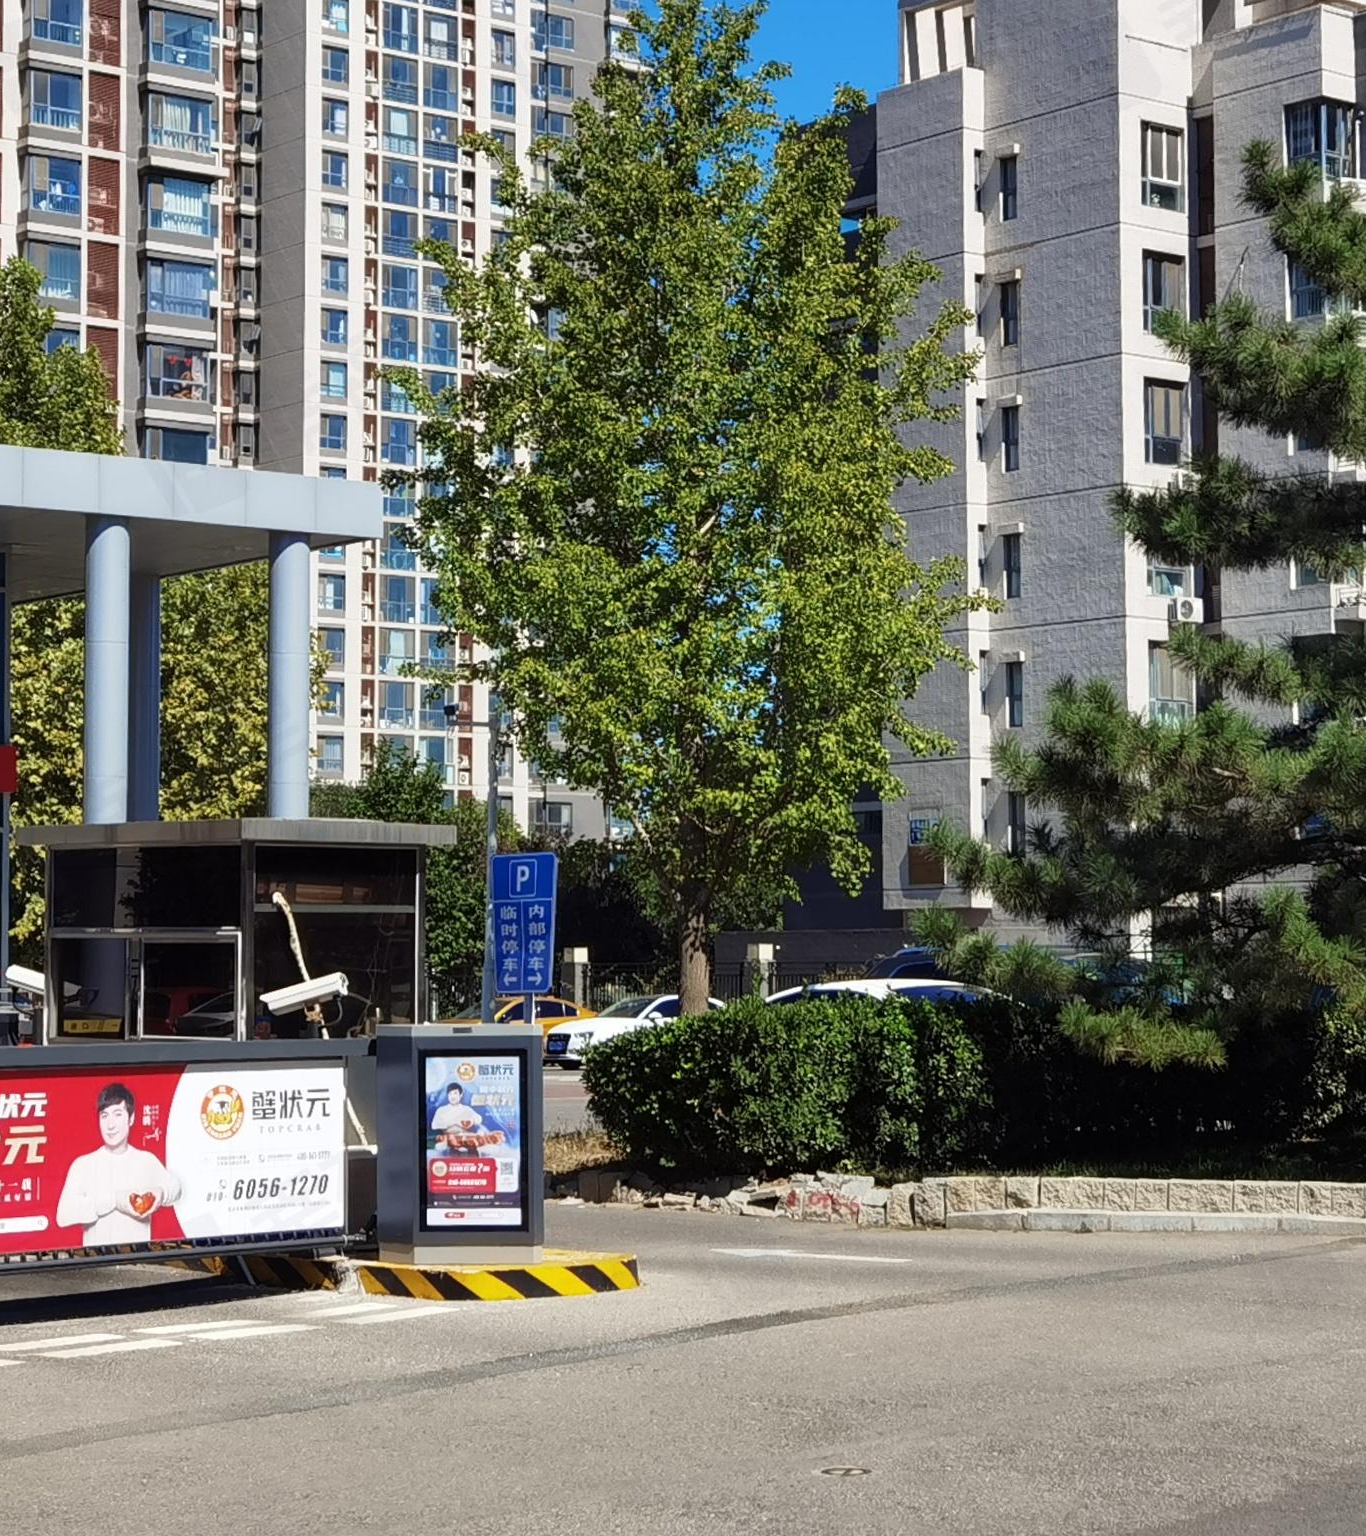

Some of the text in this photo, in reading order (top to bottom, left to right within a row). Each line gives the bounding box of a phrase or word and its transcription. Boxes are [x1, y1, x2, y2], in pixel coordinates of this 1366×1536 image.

[516, 865, 530, 892] P
[500, 905, 519, 972] 临时停车
[527, 904, 546, 971] 内部停车
[252, 1088, 331, 1121] 蟹状元
[259, 1123, 323, 1134] TOPCRAB
[232, 1174, 329, 1201] 6056-1270
